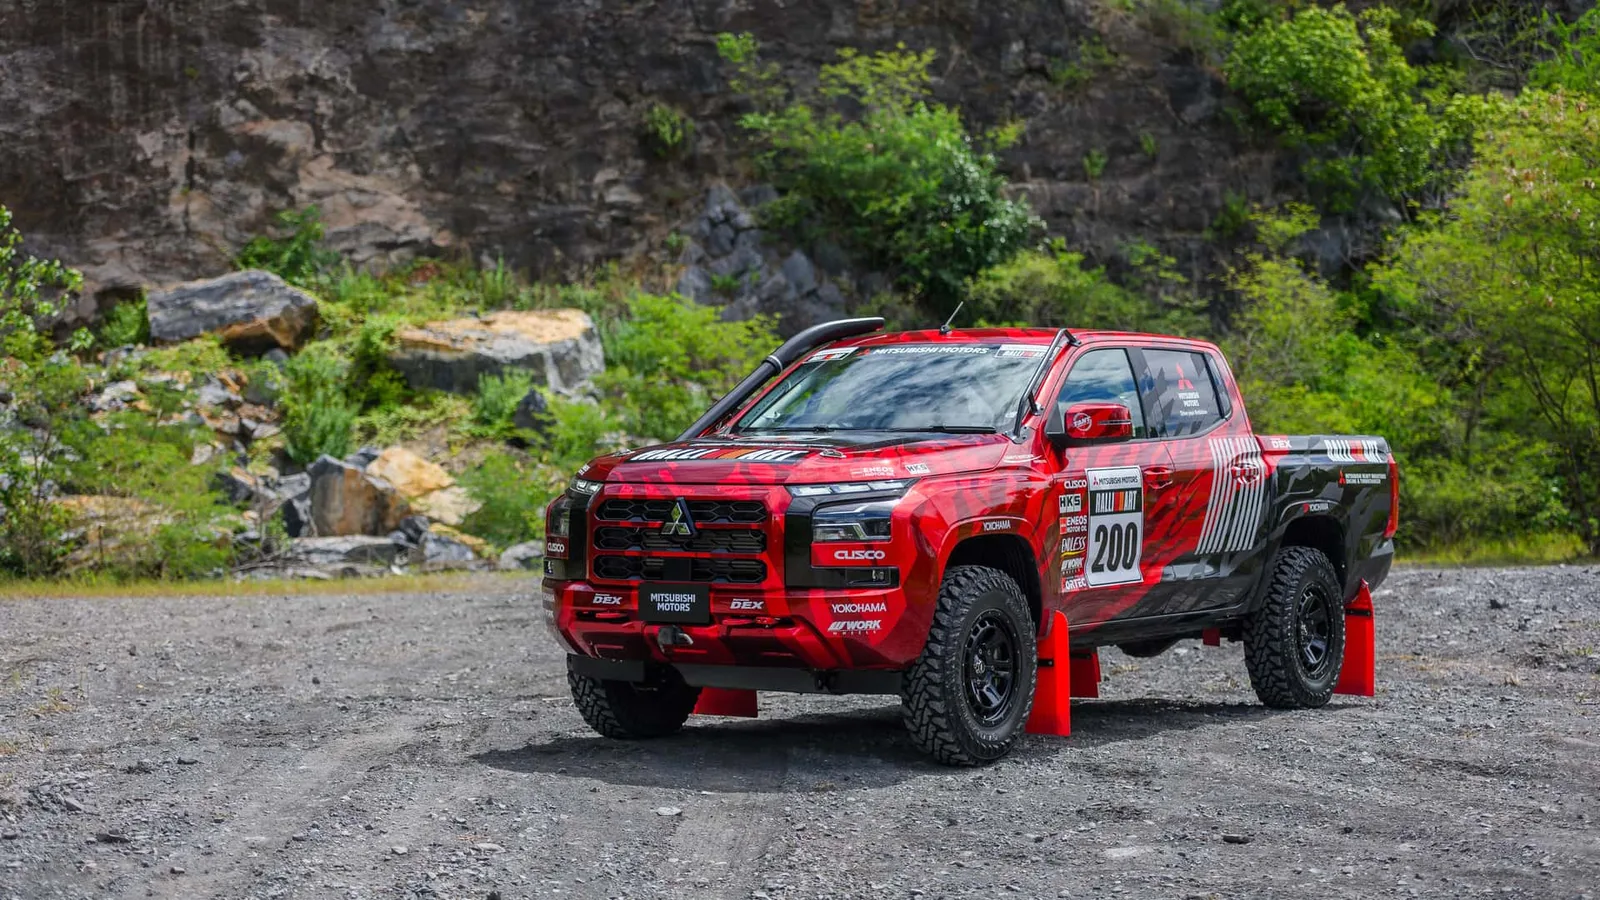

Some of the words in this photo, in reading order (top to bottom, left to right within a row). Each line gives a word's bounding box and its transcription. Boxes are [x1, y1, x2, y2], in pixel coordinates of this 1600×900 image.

[1271, 440, 1293, 449] DEX
[907, 464, 927, 472] HKS
[1064, 480, 1087, 489] CUSCO
[1099, 477, 1121, 485] MITSUBISHI
[1060, 495, 1080, 507] HKS
[1067, 515, 1087, 526] ENEOS
[983, 520, 1011, 532] YOKOHAMA
[547, 542, 565, 553] CUSCO
[1091, 521, 1138, 573] 200
[834, 550, 886, 560] CUSCO
[592, 596, 623, 605] DEX
[650, 593, 696, 603] MITSUBISHI
[657, 603, 691, 612] MOTORS
[730, 601, 764, 610] DEX
[831, 602, 887, 613] YOKOHAMA
[848, 620, 882, 630] WORK
